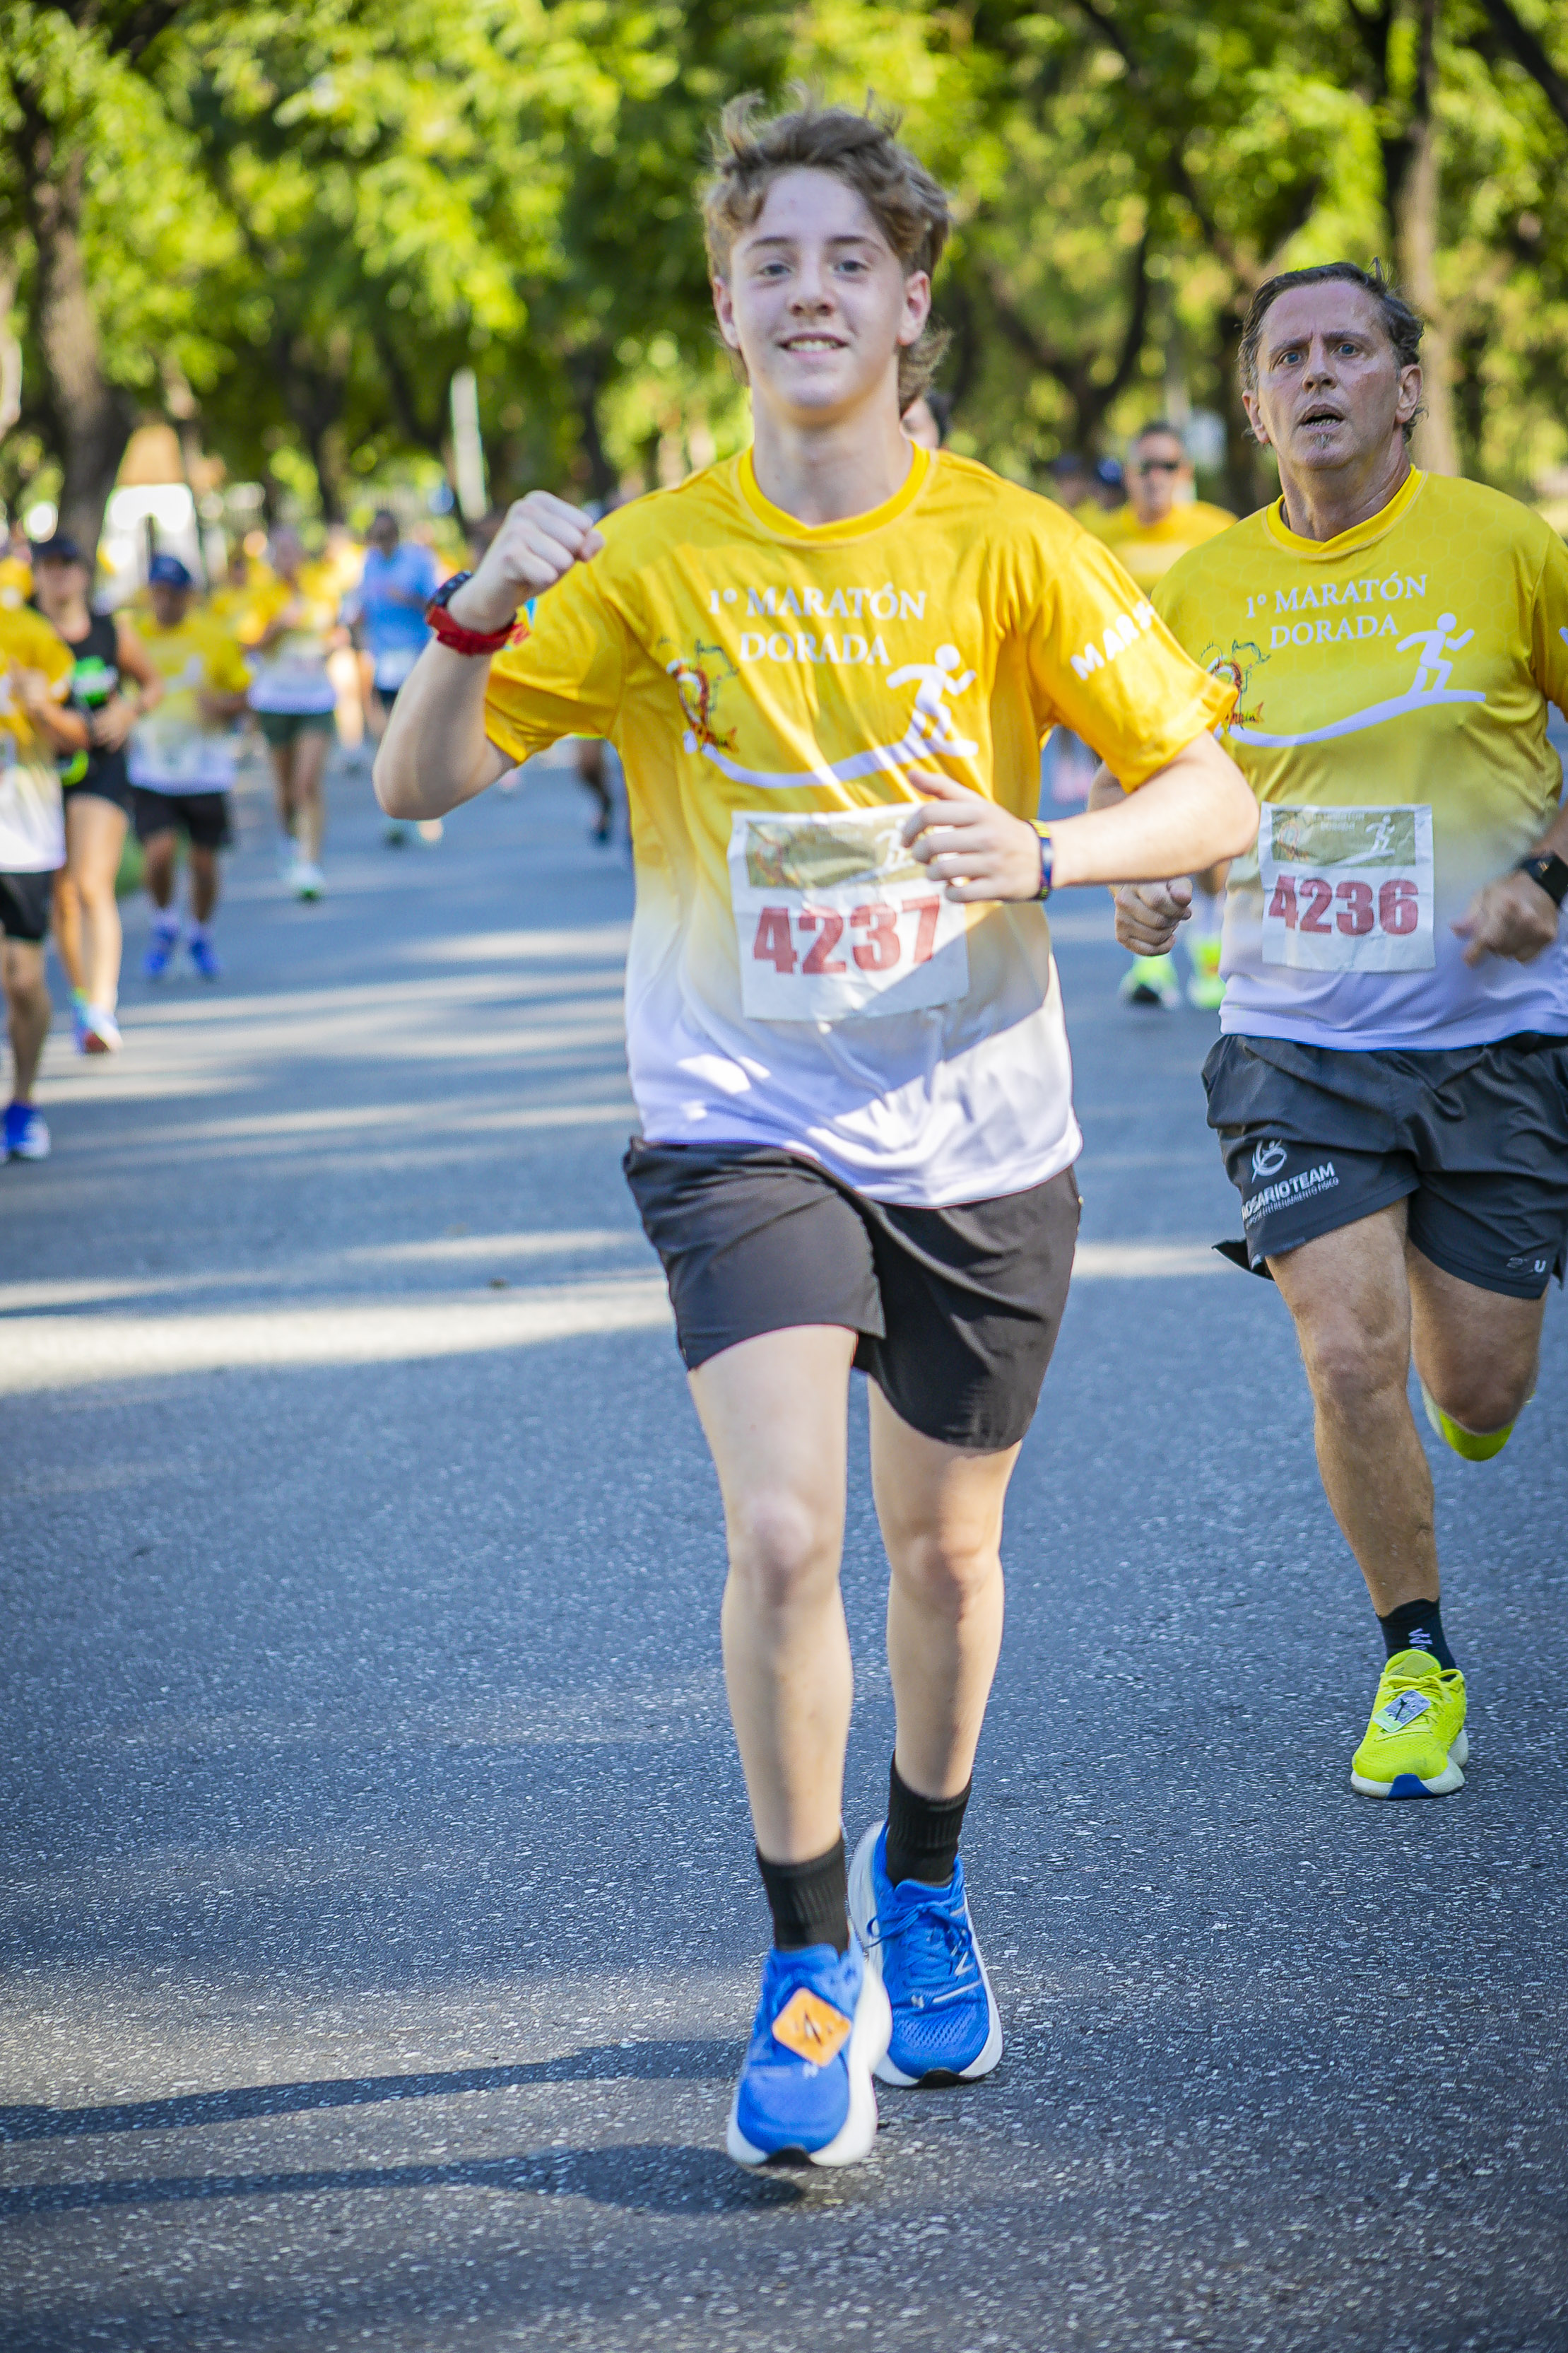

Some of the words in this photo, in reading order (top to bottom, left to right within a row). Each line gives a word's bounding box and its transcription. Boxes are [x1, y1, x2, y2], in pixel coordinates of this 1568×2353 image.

[746, 581, 927, 621] MARATÓN
[1275, 571, 1427, 614] MARATÓN
[740, 632, 891, 666] DORADA
[1270, 613, 1398, 650] DORADA
[1268, 874, 1419, 937] 4236
[753, 894, 940, 975] 4237
